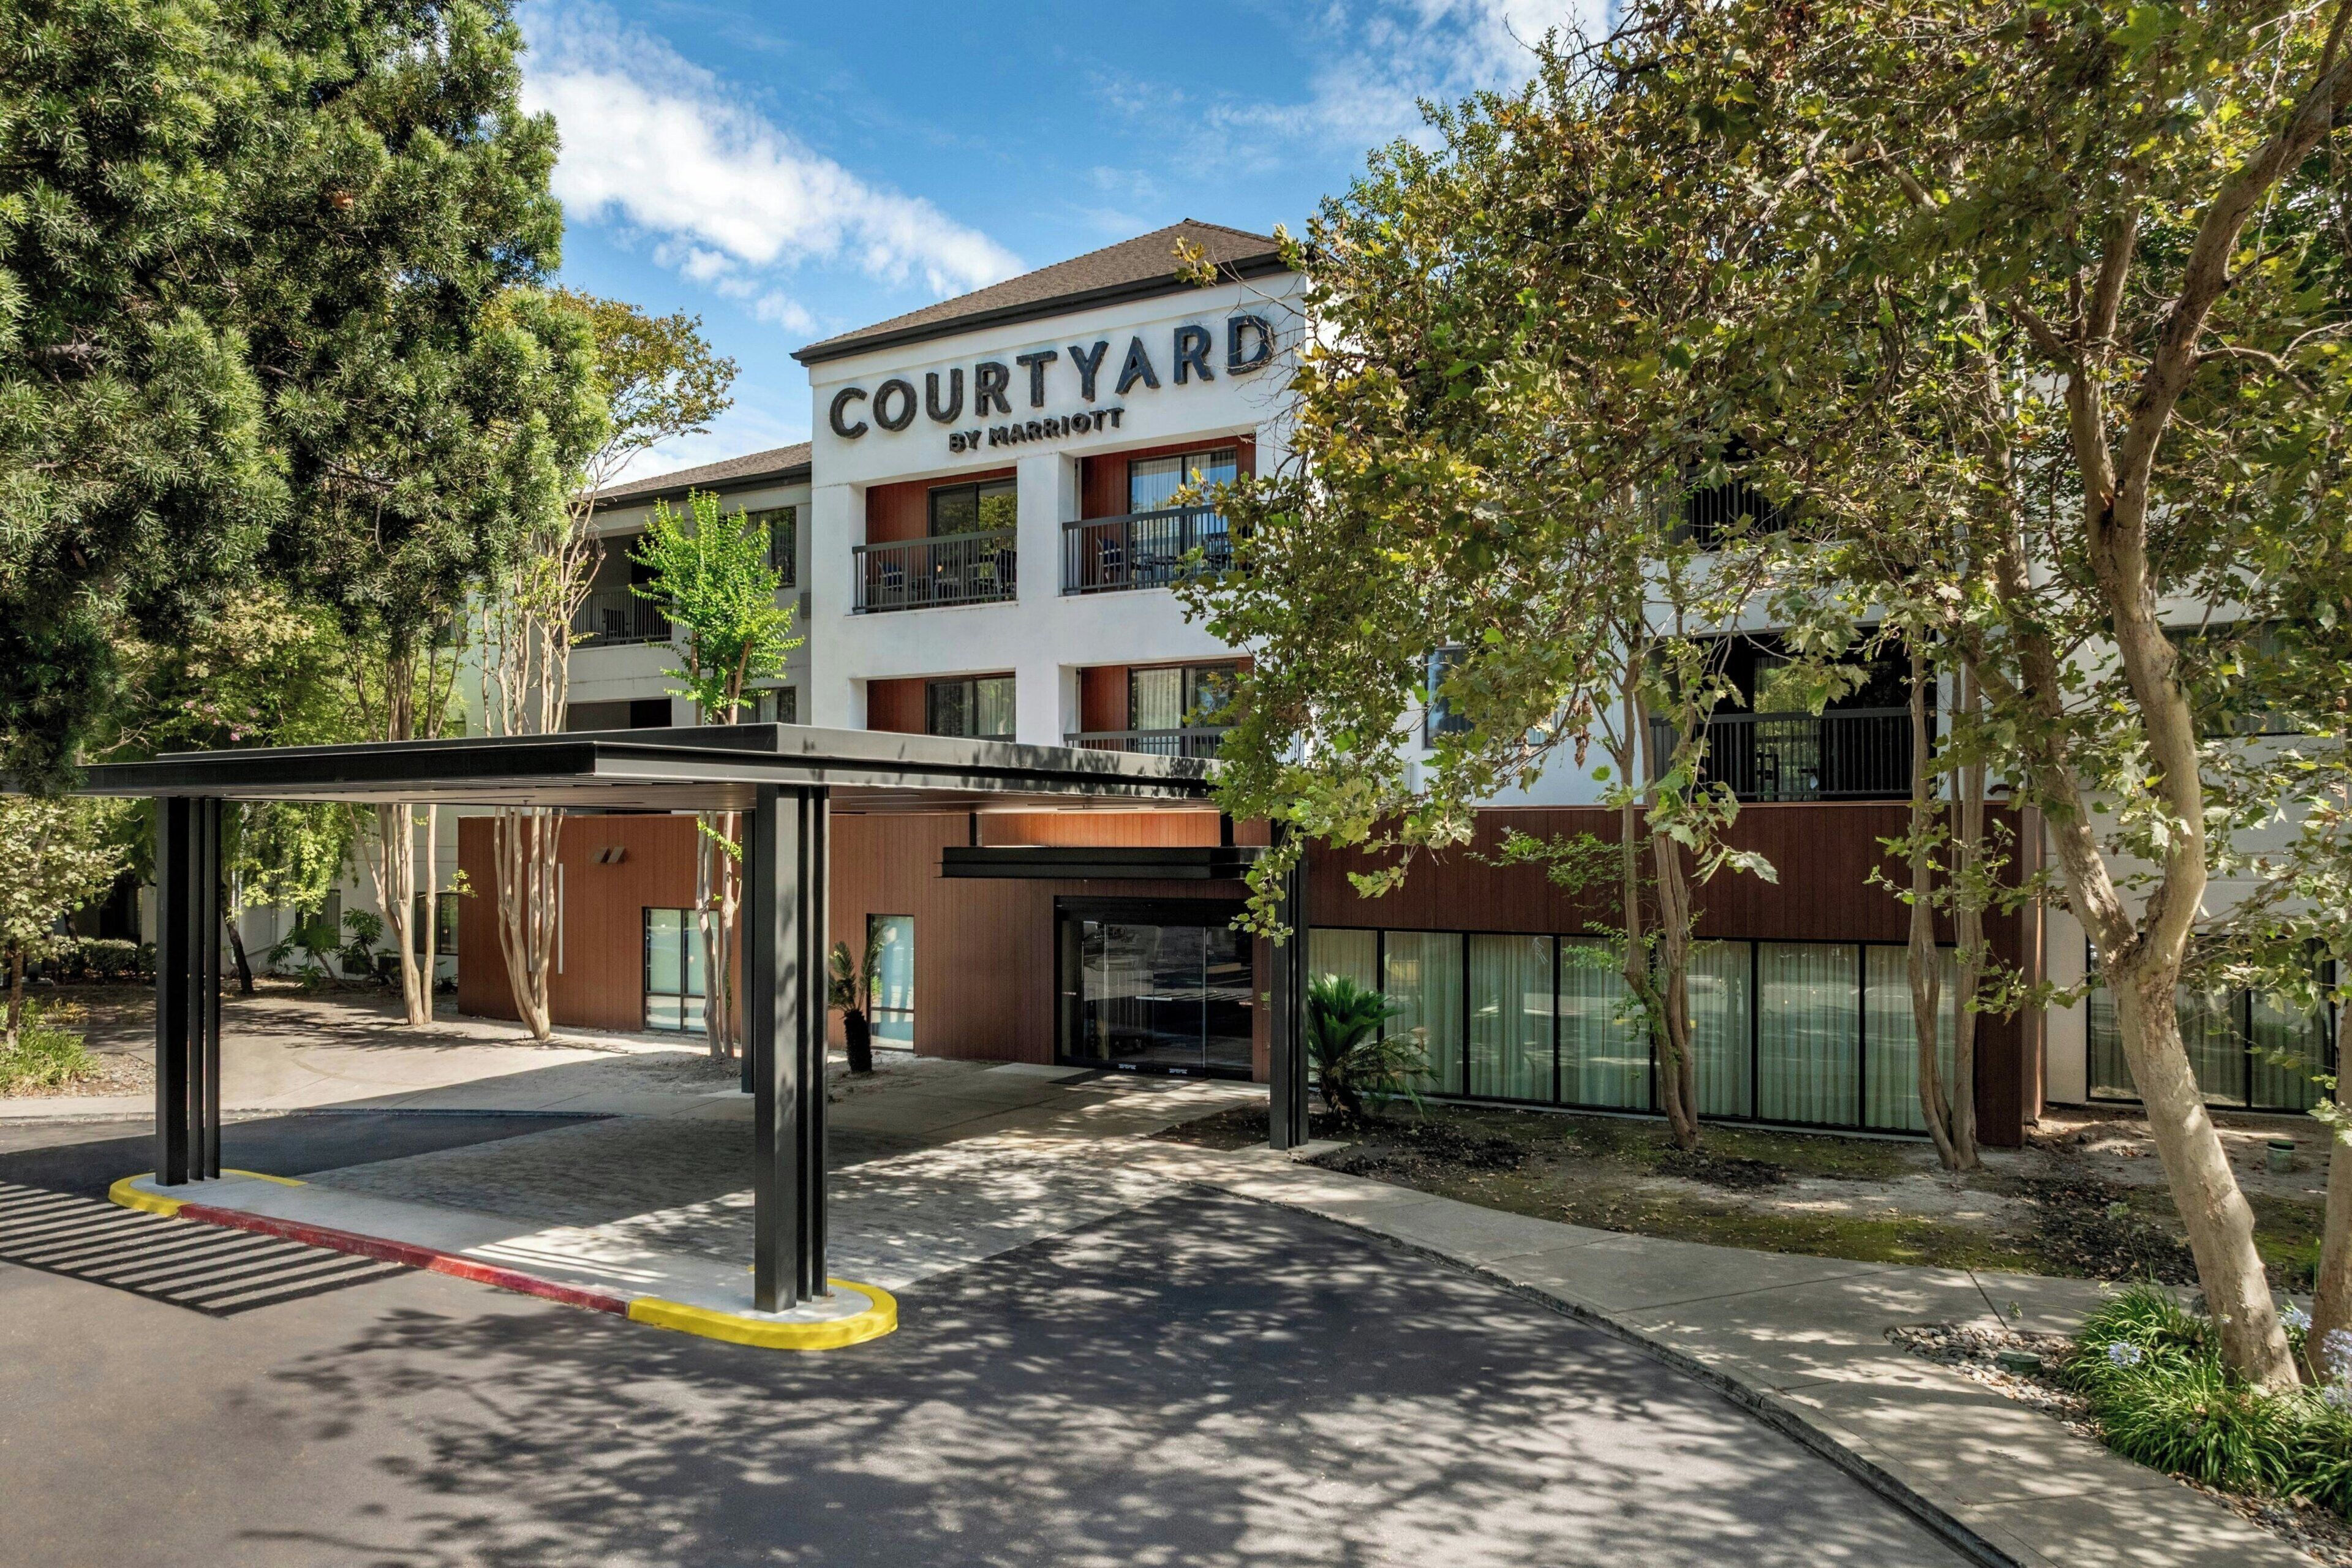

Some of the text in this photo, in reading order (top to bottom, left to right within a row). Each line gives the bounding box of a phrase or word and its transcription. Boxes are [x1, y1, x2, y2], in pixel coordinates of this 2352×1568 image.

[829, 315, 1275, 439] COURTYARD
[949, 407, 1125, 453] BY MARRIOTT
